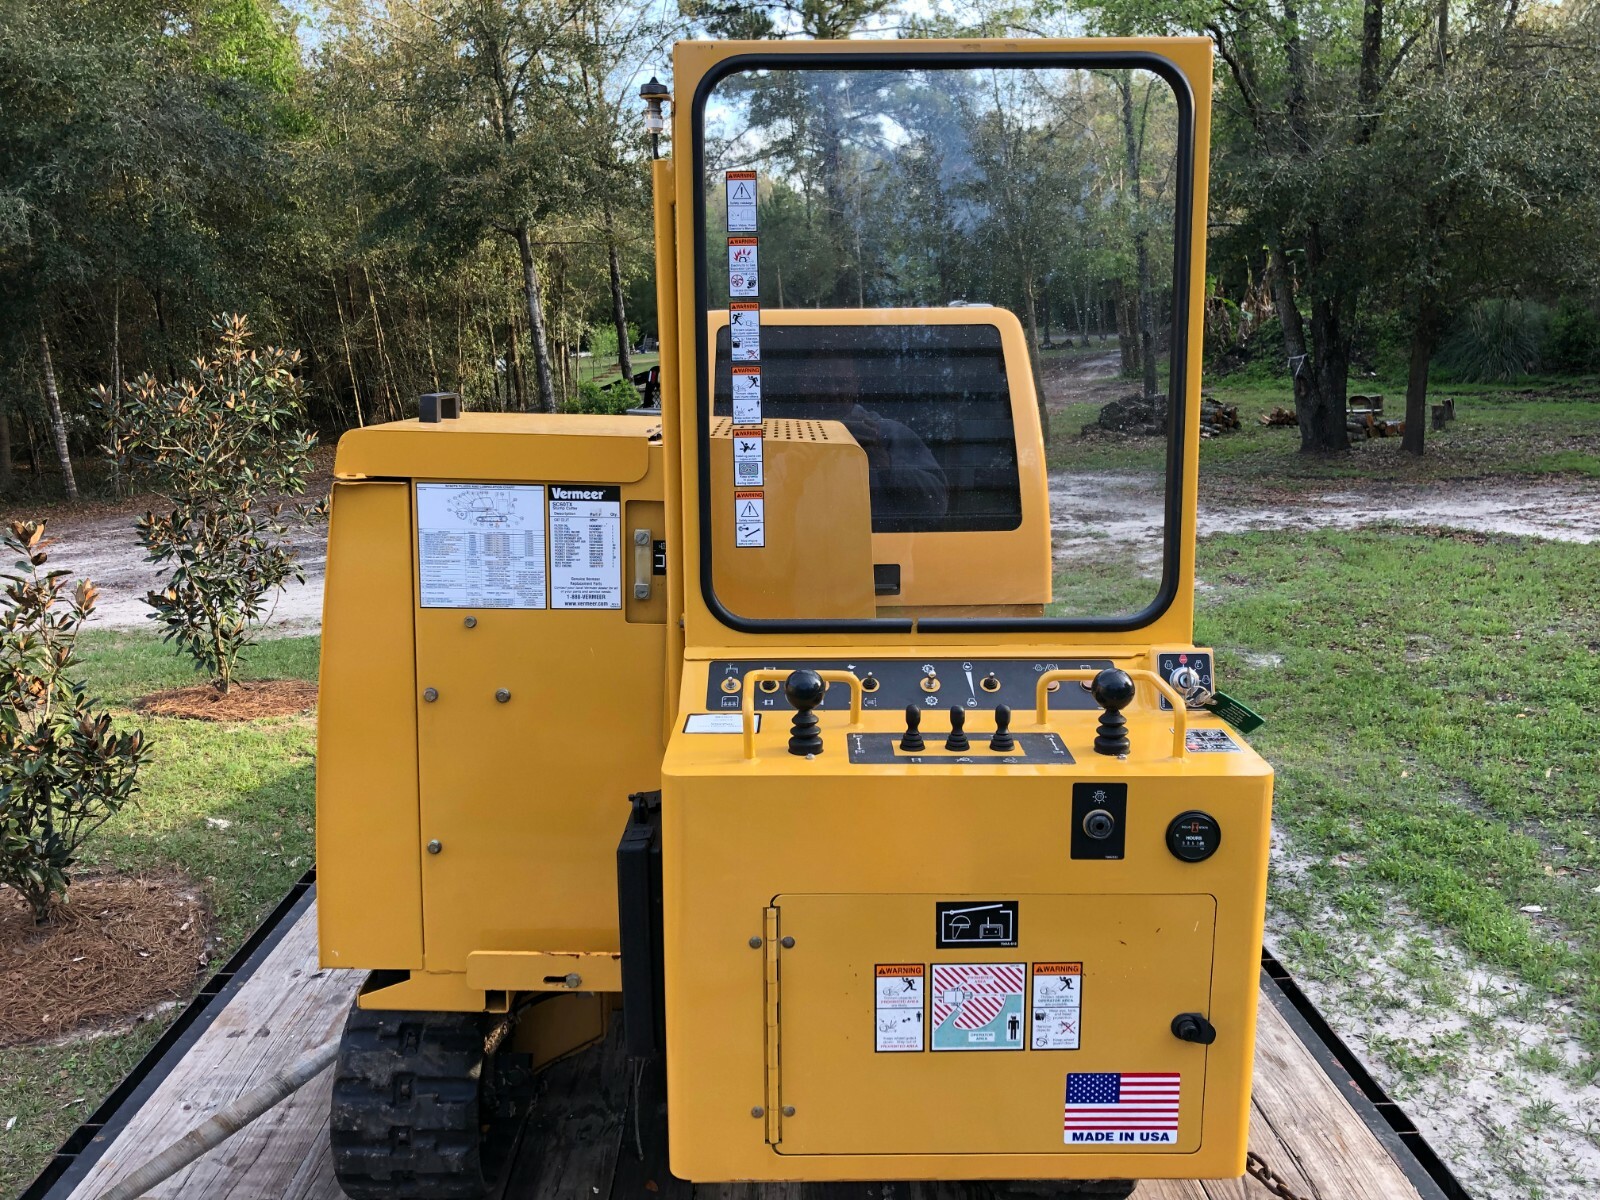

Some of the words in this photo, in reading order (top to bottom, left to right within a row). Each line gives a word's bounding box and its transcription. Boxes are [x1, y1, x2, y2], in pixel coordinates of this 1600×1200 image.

[551, 487, 604, 500] Vermeer
[1072, 1132, 1114, 1141] MADE
[1119, 1132, 1134, 1141] IN
[1140, 1132, 1170, 1141] USA
